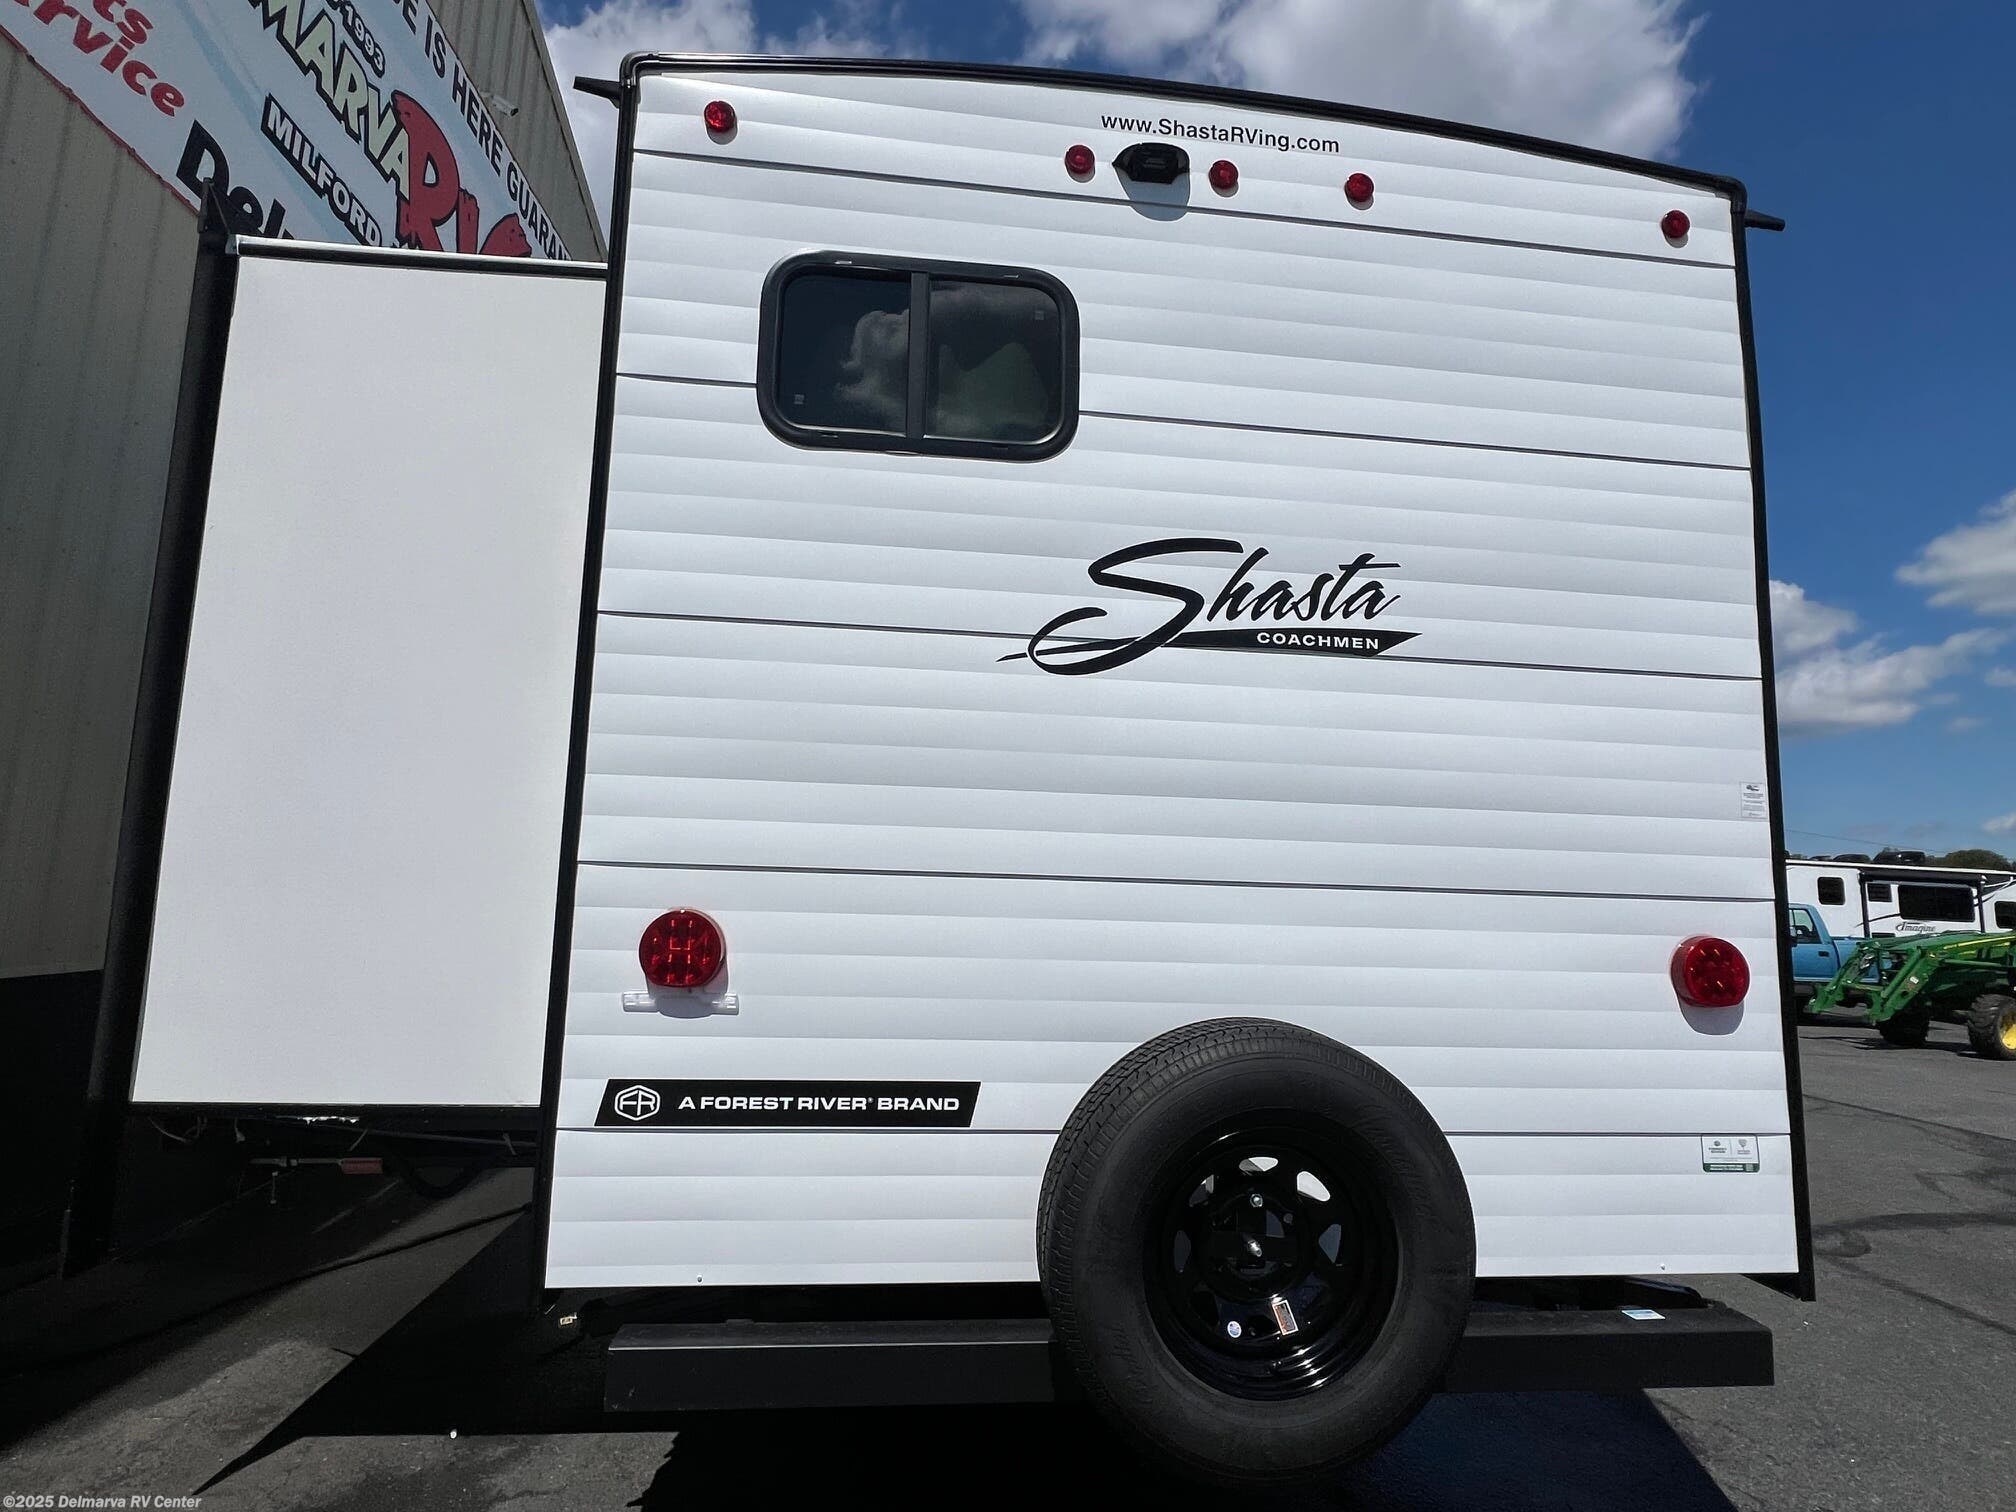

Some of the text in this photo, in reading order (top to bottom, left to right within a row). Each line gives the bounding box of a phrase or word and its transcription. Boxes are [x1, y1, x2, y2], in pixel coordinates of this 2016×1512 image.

[14, 0, 185, 117] rvice
[343, 3, 386, 77] 1993
[424, 14, 447, 79] IS
[452, 63, 505, 178] HERE
[175, 119, 295, 241] Del
[262, 95, 392, 247] MILFORD
[1101, 115, 1340, 153] www.ShastaRVing.com
[1028, 537, 1401, 676] Shasta
[1256, 632, 1380, 650] COACHMEN
[678, 1097, 696, 1110] A
[701, 1097, 794, 1111] FOREST
[877, 1097, 960, 1112] BRAND
